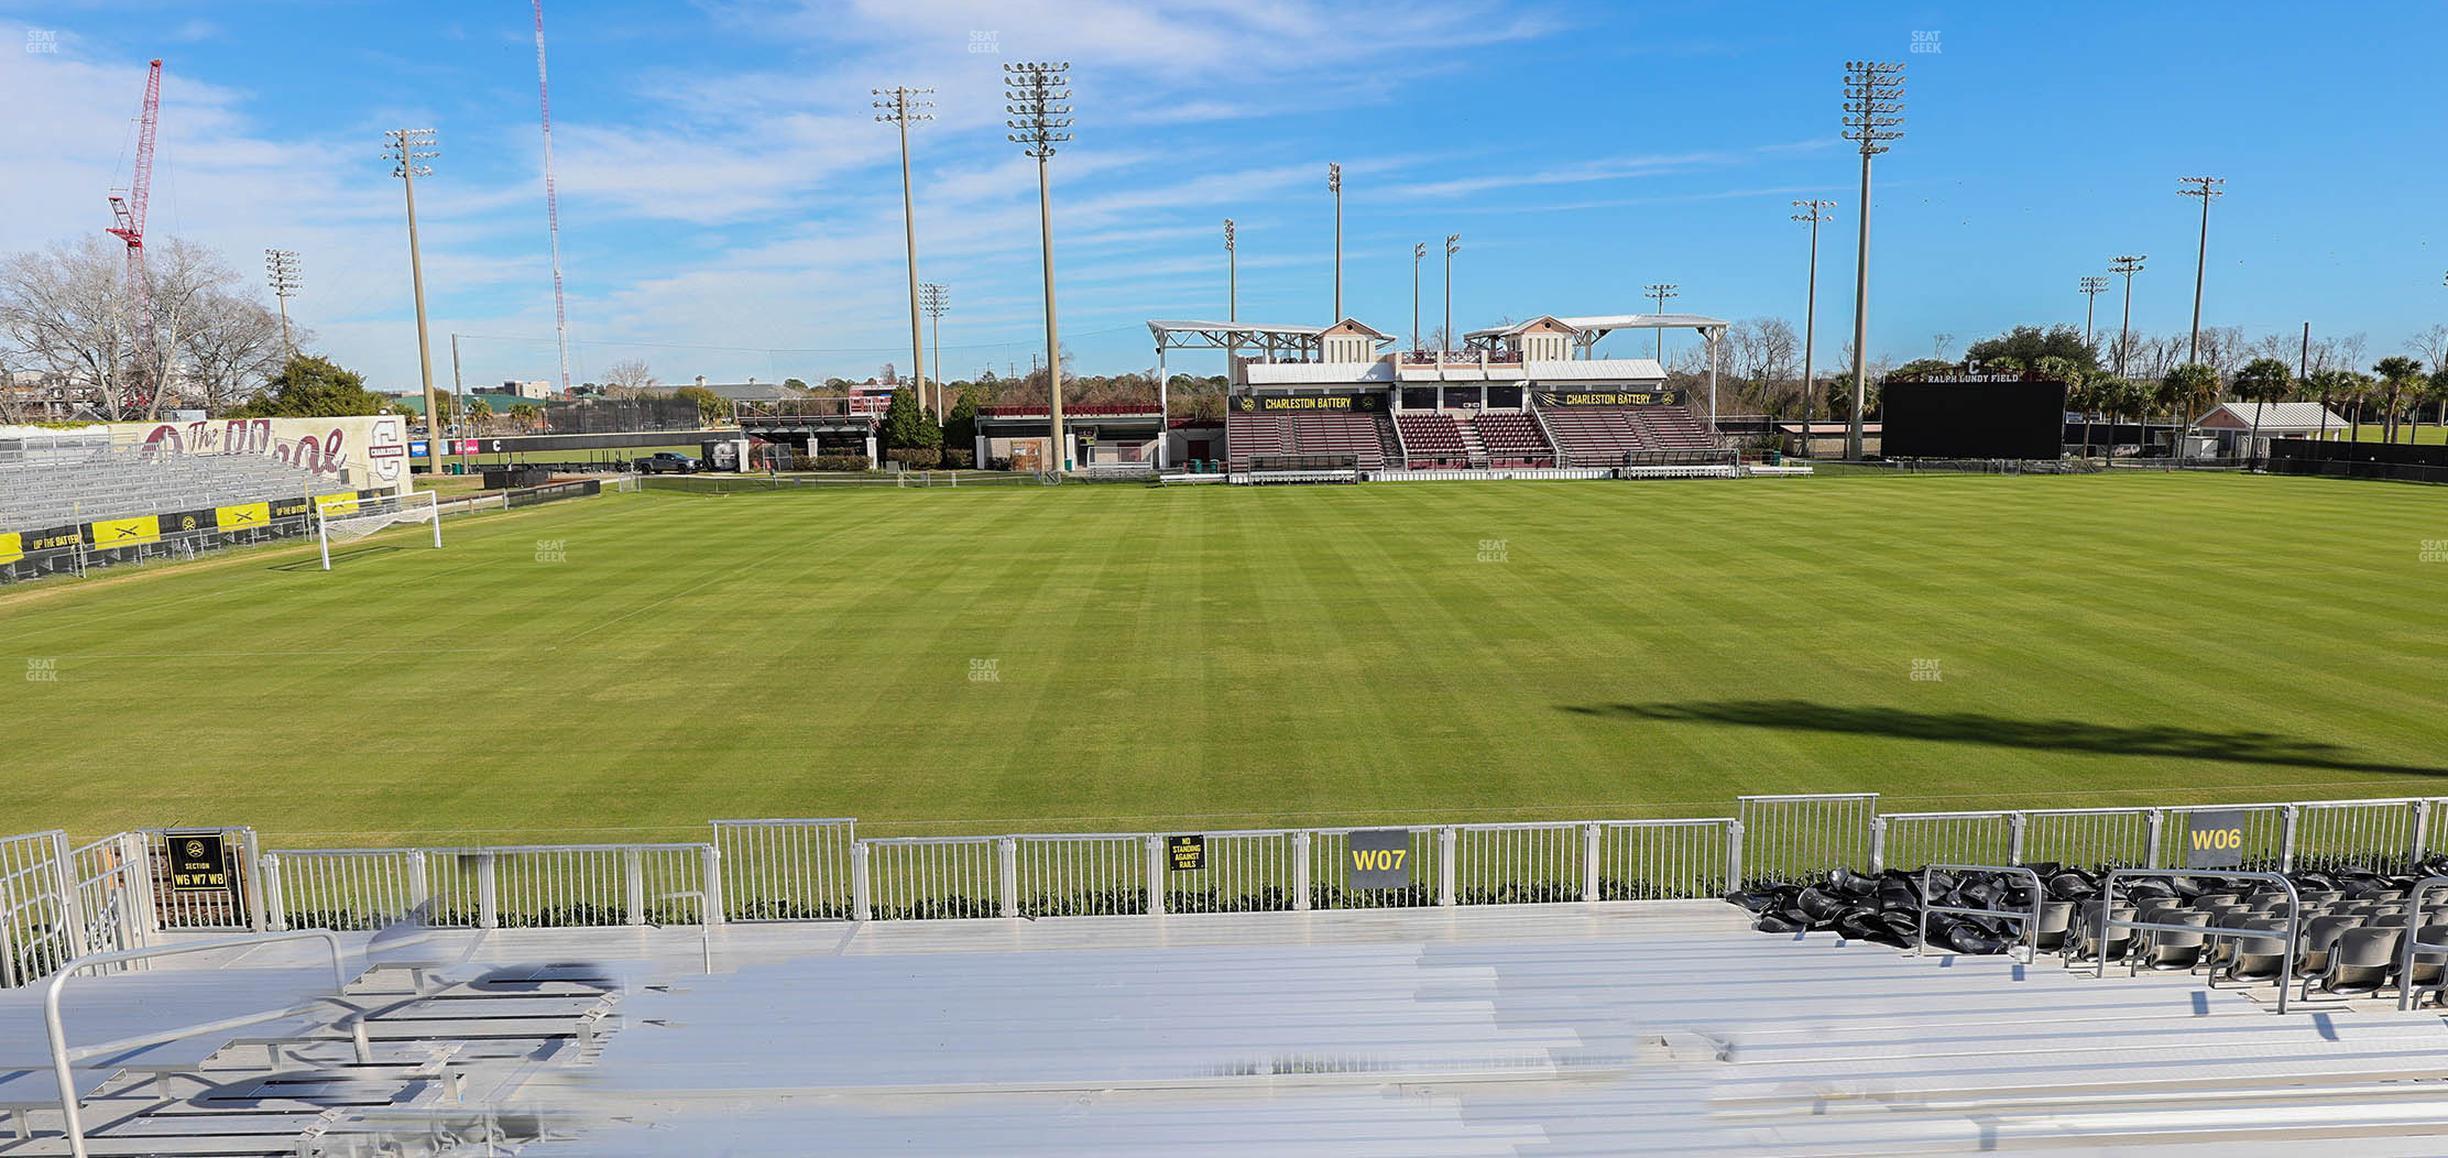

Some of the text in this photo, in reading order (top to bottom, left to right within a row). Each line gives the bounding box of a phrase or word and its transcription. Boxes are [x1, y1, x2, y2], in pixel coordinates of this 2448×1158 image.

[1928, 374, 2019, 383] RALPH LUNDY FIELD
[1265, 397, 1351, 409] CHARLESTON BATTERY
[1566, 393, 1651, 405] CHARLESTON BATTERY
[1181, 837, 1191, 845] NO
[2192, 828, 2241, 850] W06
[1172, 844, 1201, 854] STANDING
[1175, 852, 1199, 861] AGAINST
[1352, 849, 1407, 871] W07
[184, 862, 210, 870] SECTION
[1179, 860, 1197, 869] RAILS
[174, 873, 225, 886] W6 W7 W8
